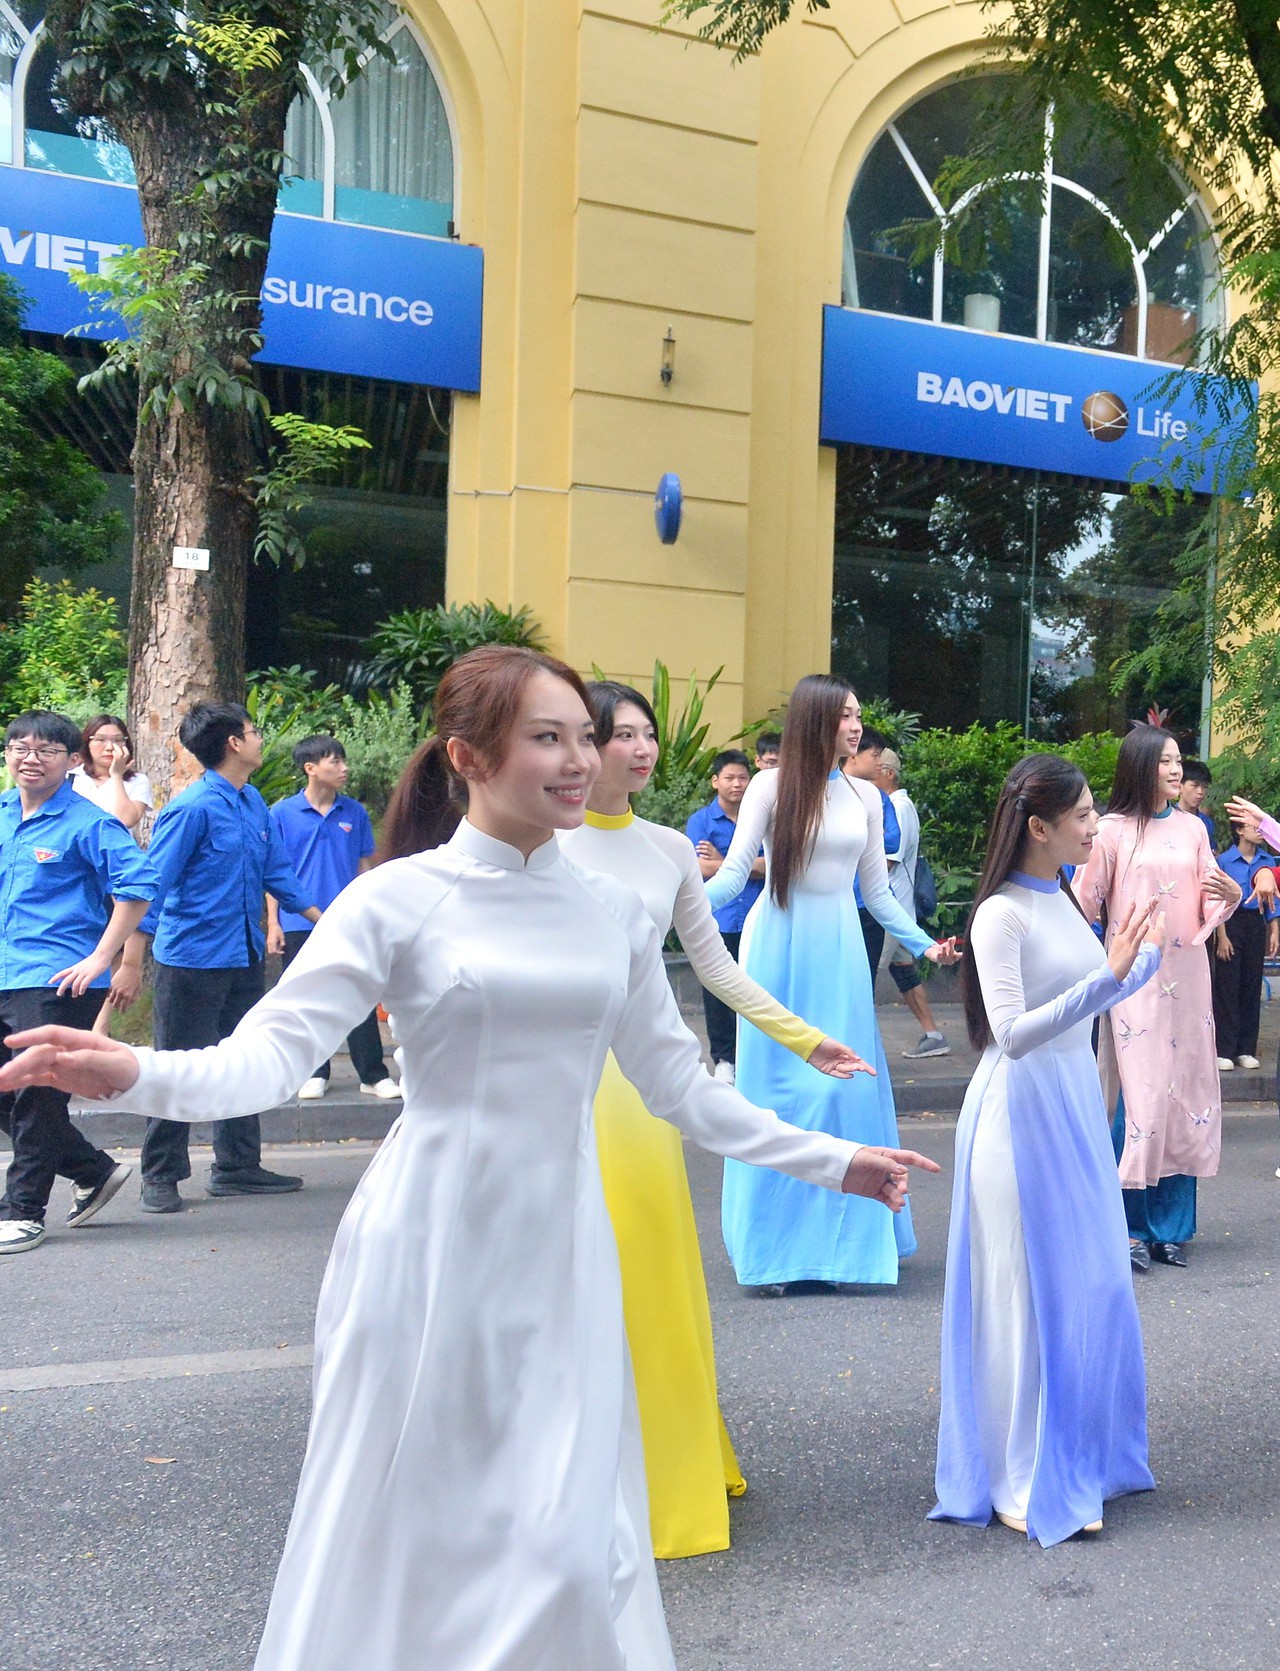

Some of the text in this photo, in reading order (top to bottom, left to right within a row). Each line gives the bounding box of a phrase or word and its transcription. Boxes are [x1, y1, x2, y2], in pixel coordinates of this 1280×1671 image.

[259, 276, 434, 326] surance
[916, 371, 1187, 441] BAOVIET Life
[185, 552, 199, 561] 18
